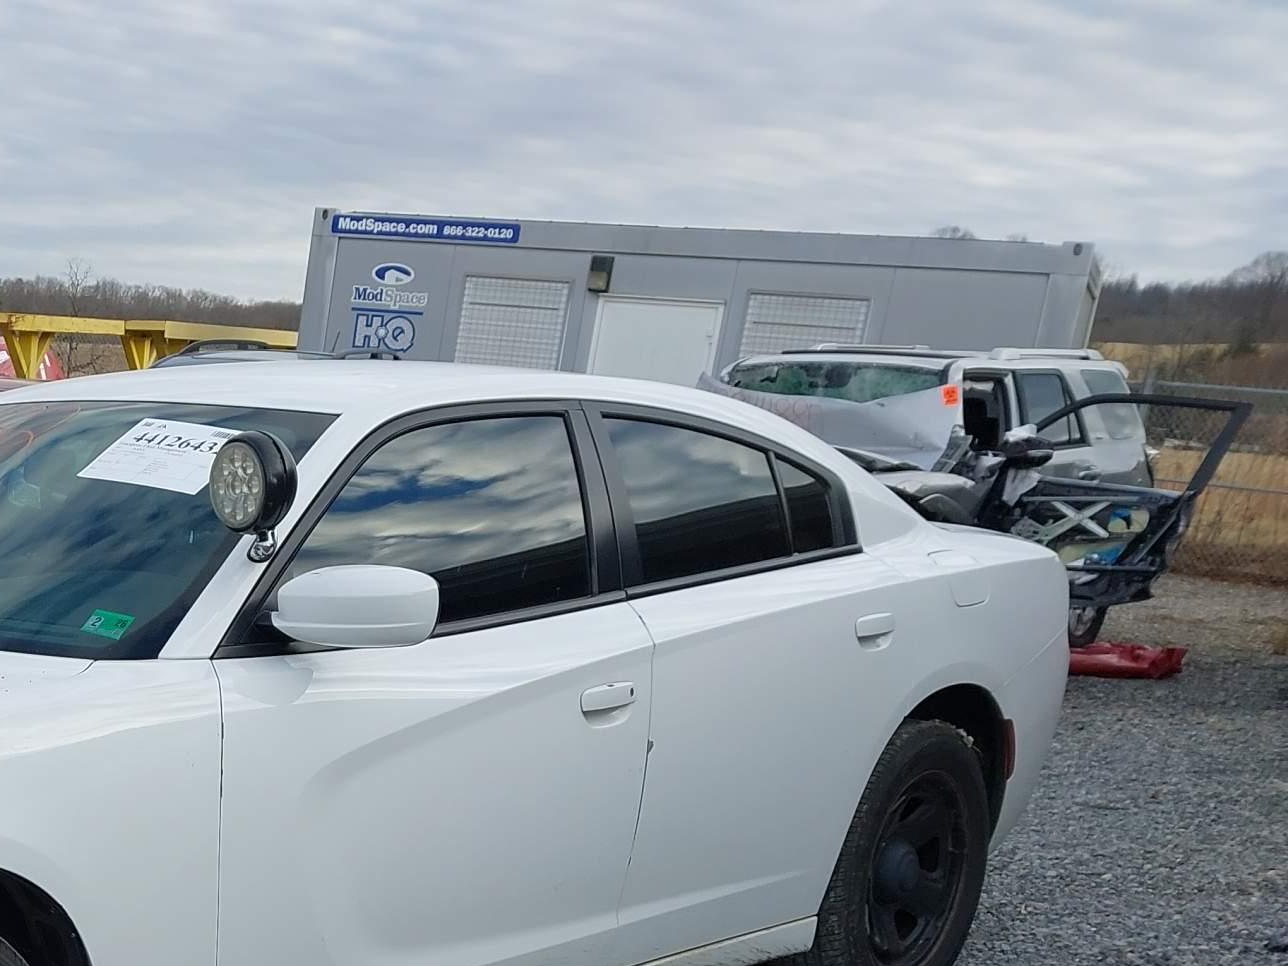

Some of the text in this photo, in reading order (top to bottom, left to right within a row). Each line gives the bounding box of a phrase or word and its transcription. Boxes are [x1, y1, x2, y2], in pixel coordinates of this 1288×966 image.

[338, 217, 438, 234] ModSpace.com
[353, 286, 426, 307] ModSpace
[352, 313, 415, 353] HQ
[133, 431, 219, 455] 4412643
[90, 616, 103, 628] 2
